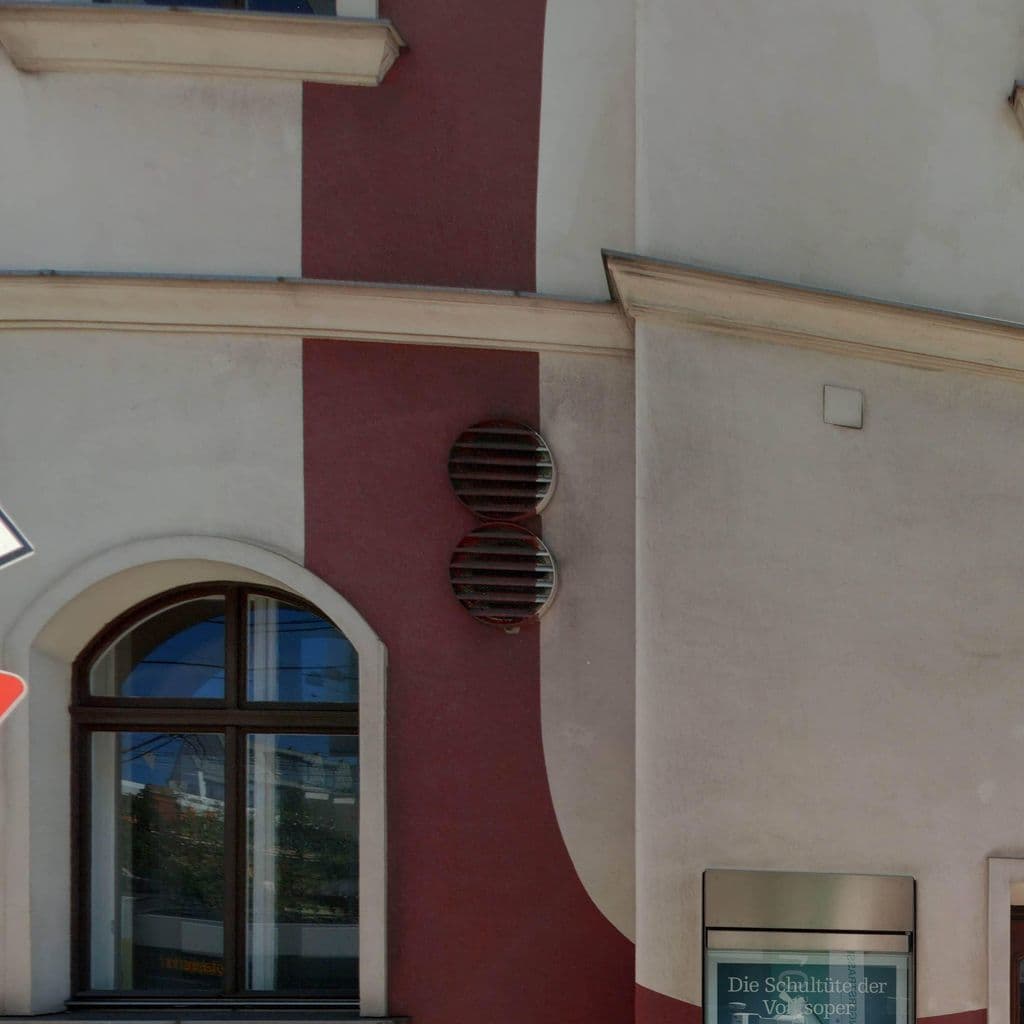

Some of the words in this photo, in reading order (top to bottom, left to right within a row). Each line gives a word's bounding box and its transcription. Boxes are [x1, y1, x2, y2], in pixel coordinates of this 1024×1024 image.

[728, 976, 759, 993] Die
[765, 976, 851, 993] Schultüte
[857, 977, 887, 994] der
[762, 998, 855, 1020] Volsoper
